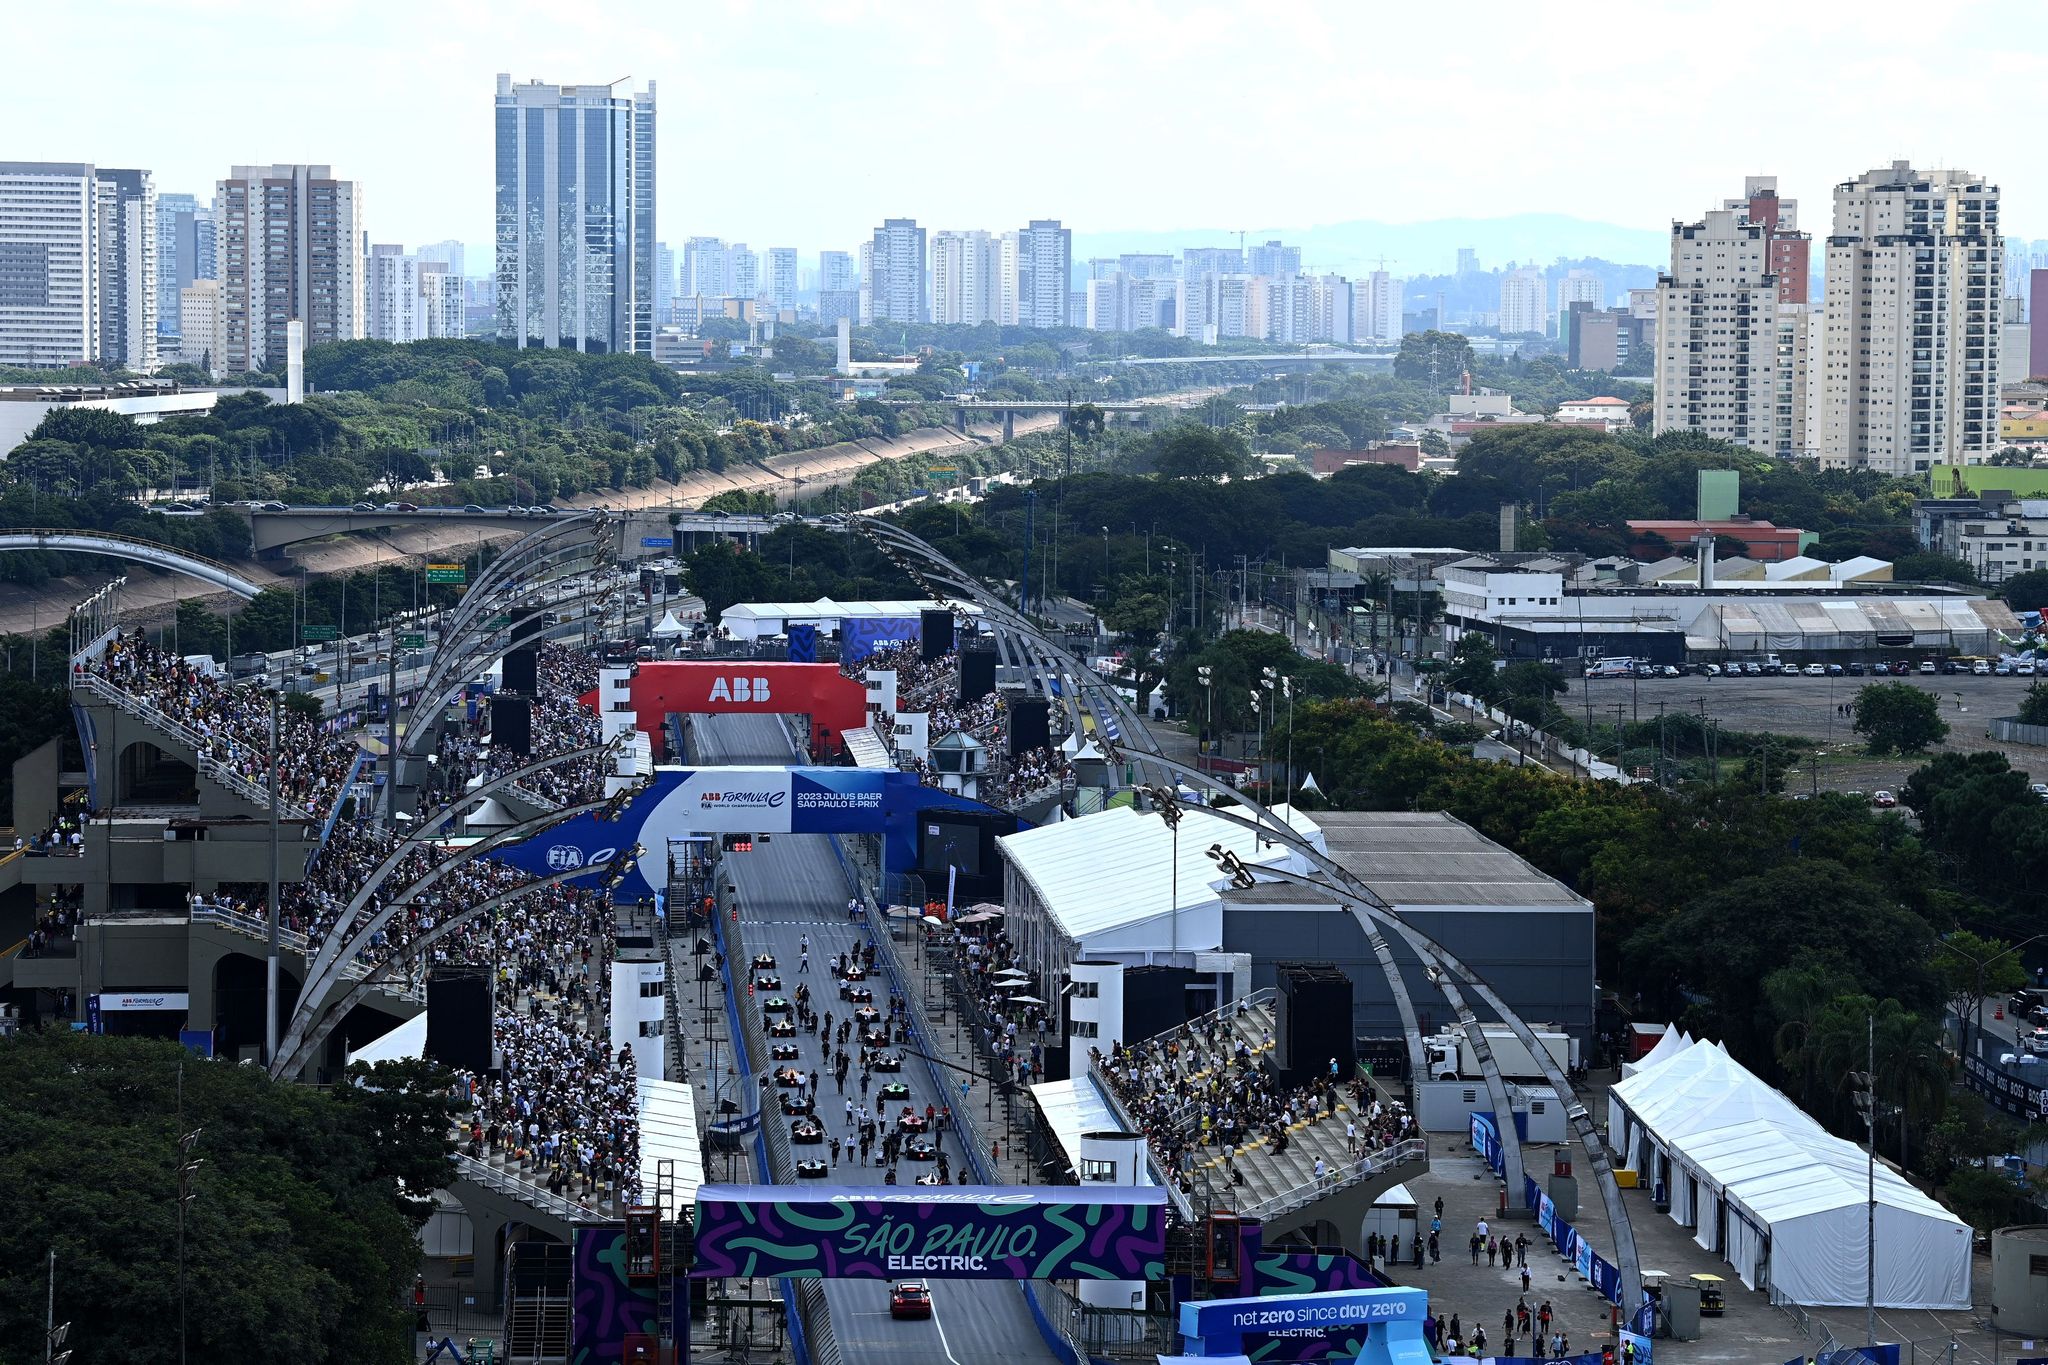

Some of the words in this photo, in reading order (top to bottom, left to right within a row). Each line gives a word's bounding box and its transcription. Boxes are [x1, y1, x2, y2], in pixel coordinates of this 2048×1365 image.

[708, 677, 771, 702] ABB
[701, 793, 721, 801] ABB
[797, 793, 822, 801] 2023
[823, 793, 856, 801] JULIUS
[857, 793, 883, 801] BAER
[817, 800, 848, 808] PAULO
[849, 800, 879, 808] E-PRIX
[2010, 1082, 2024, 1098] BOSS
[839, 1215, 915, 1258] SÃO
[920, 1222, 1038, 1261] PAULO.
[887, 1255, 988, 1271] ELECTRIC.
[1233, 1310, 1258, 1327] net
[1260, 1309, 1295, 1325] zero
[1297, 1306, 1337, 1322] since
[1340, 1304, 1368, 1320] day
[1371, 1300, 1406, 1317] zero
